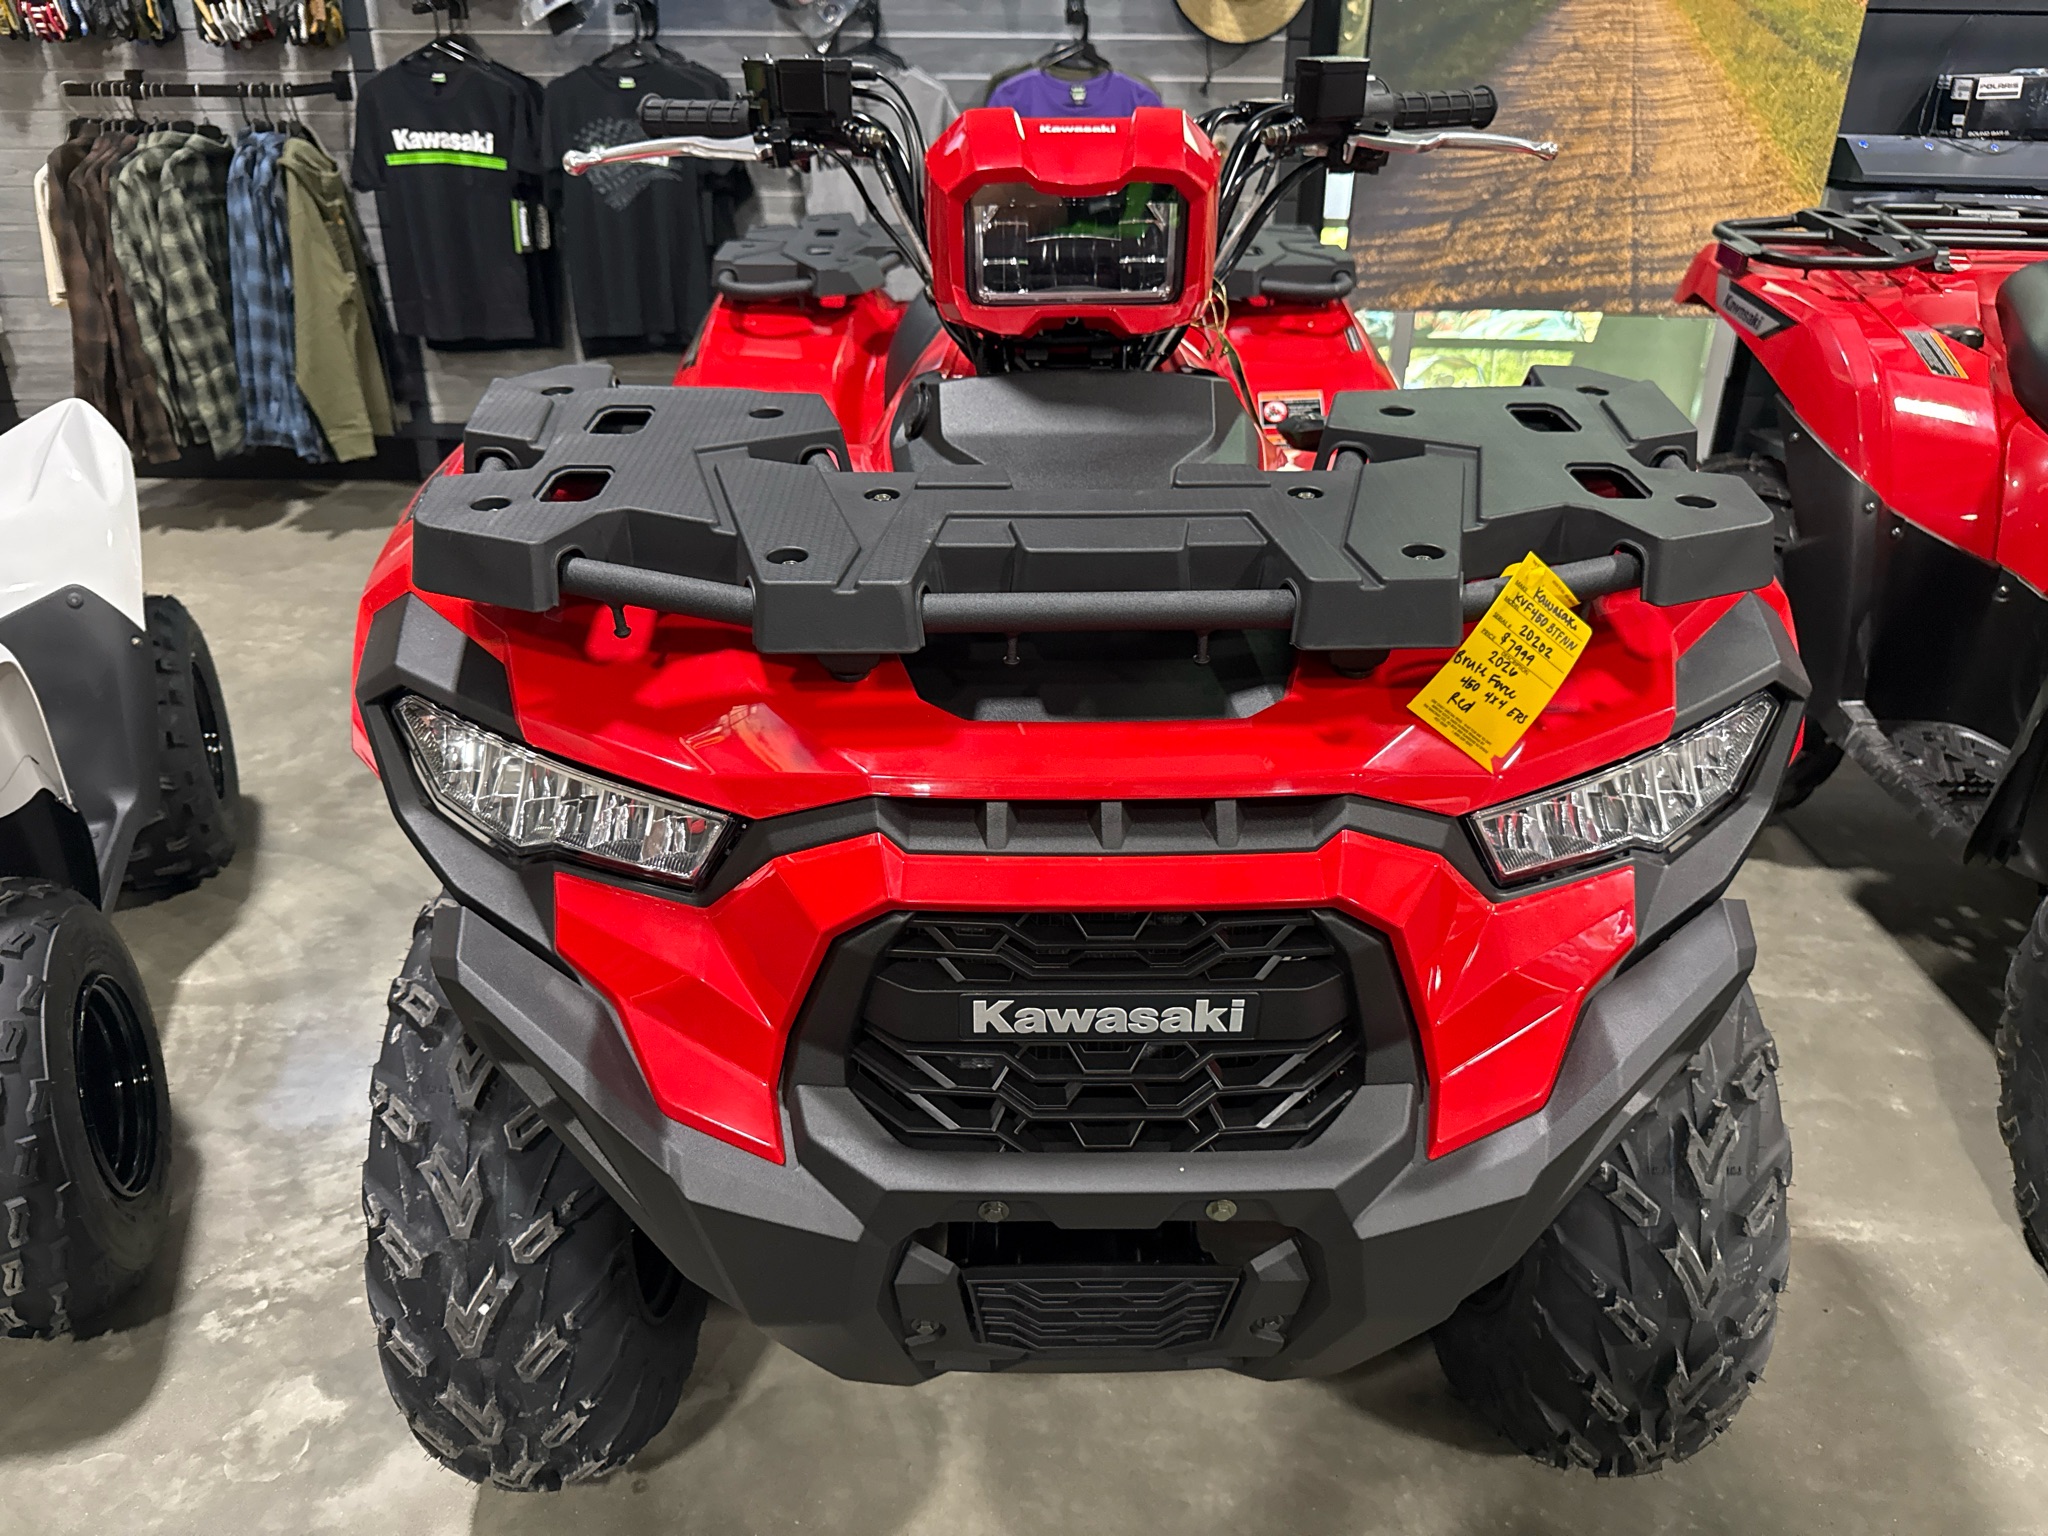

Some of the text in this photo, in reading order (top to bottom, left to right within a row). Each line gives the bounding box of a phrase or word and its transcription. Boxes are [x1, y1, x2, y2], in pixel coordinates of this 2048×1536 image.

[1980, 82, 2018, 90] POLARIS
[391, 127, 494, 155] Kawasaki
[1039, 124, 1117, 134] Kawasaki
[1723, 293, 1764, 330] Kawasaki
[1500, 632, 1535, 666] $7999
[1519, 625, 1553, 659] 20202
[1453, 650, 1516, 699] Brute Force
[1488, 651, 1518, 677] 2026
[1447, 692, 1476, 713] Red
[1460, 676, 1481, 692] 450
[1506, 707, 1529, 724] EPS
[973, 999, 1246, 1034] Kawasaki
